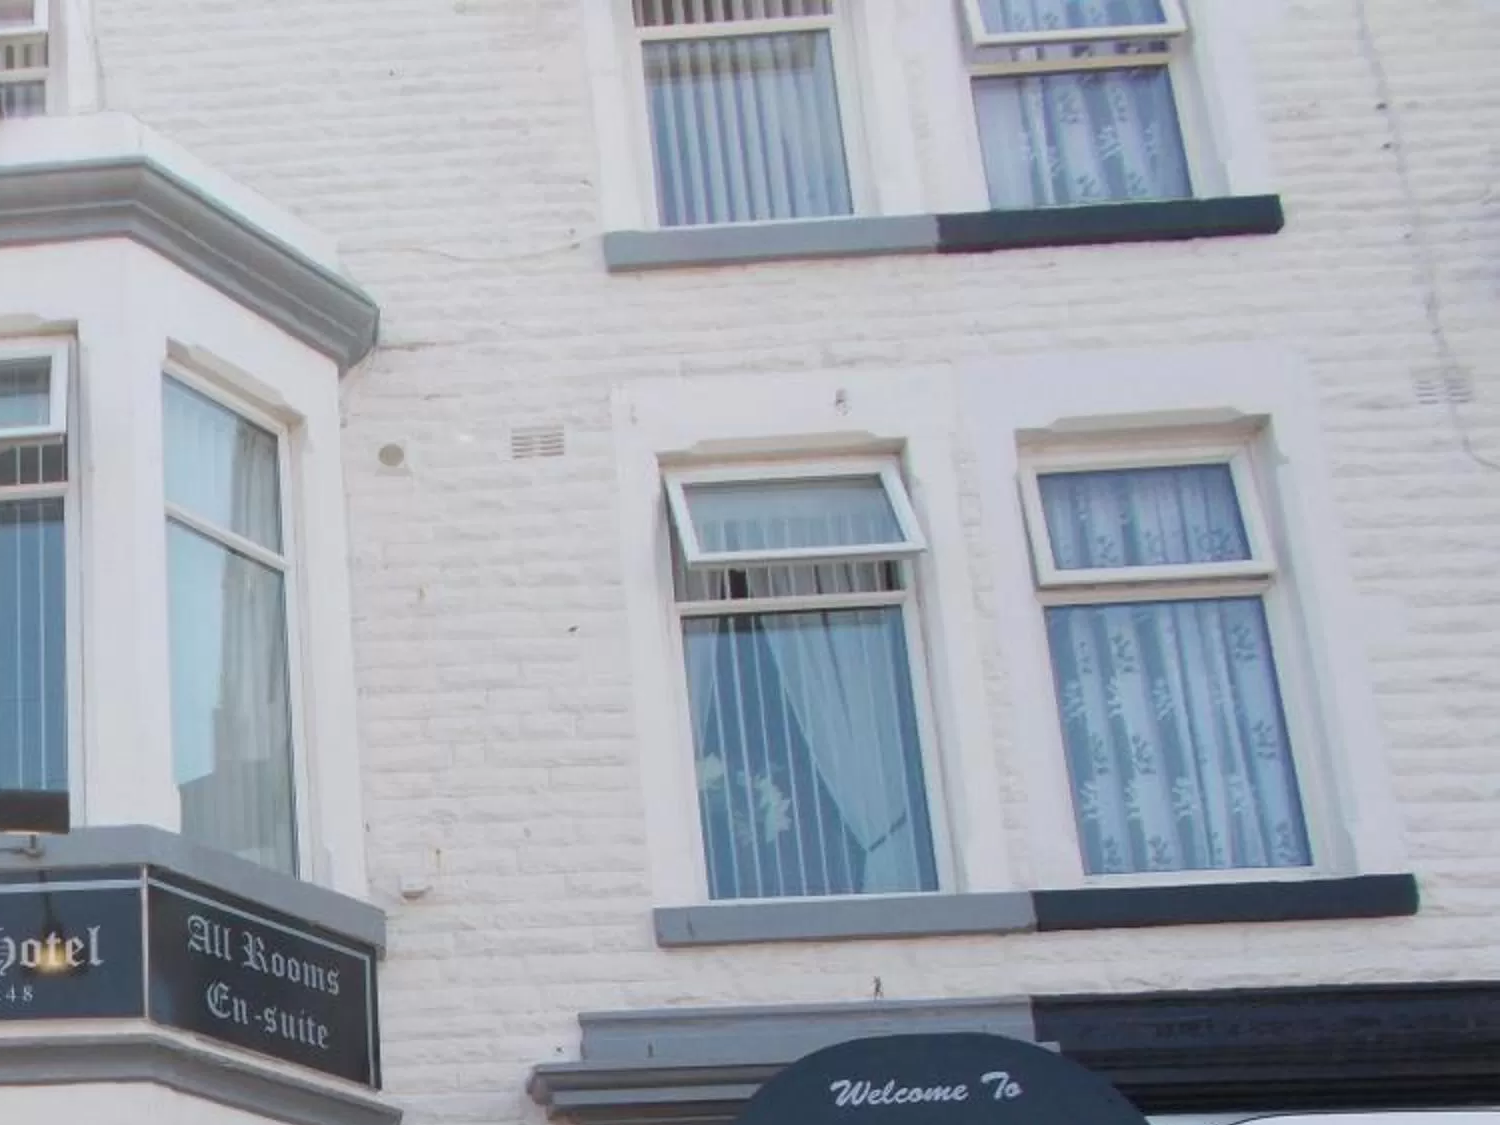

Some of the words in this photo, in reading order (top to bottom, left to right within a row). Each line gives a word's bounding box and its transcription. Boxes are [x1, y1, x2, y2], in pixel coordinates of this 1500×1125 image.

[187, 914, 232, 961] All
[241, 931, 340, 995] Rooms
[829, 1078, 970, 1108] Welcome
[980, 1071, 1024, 1099] To
